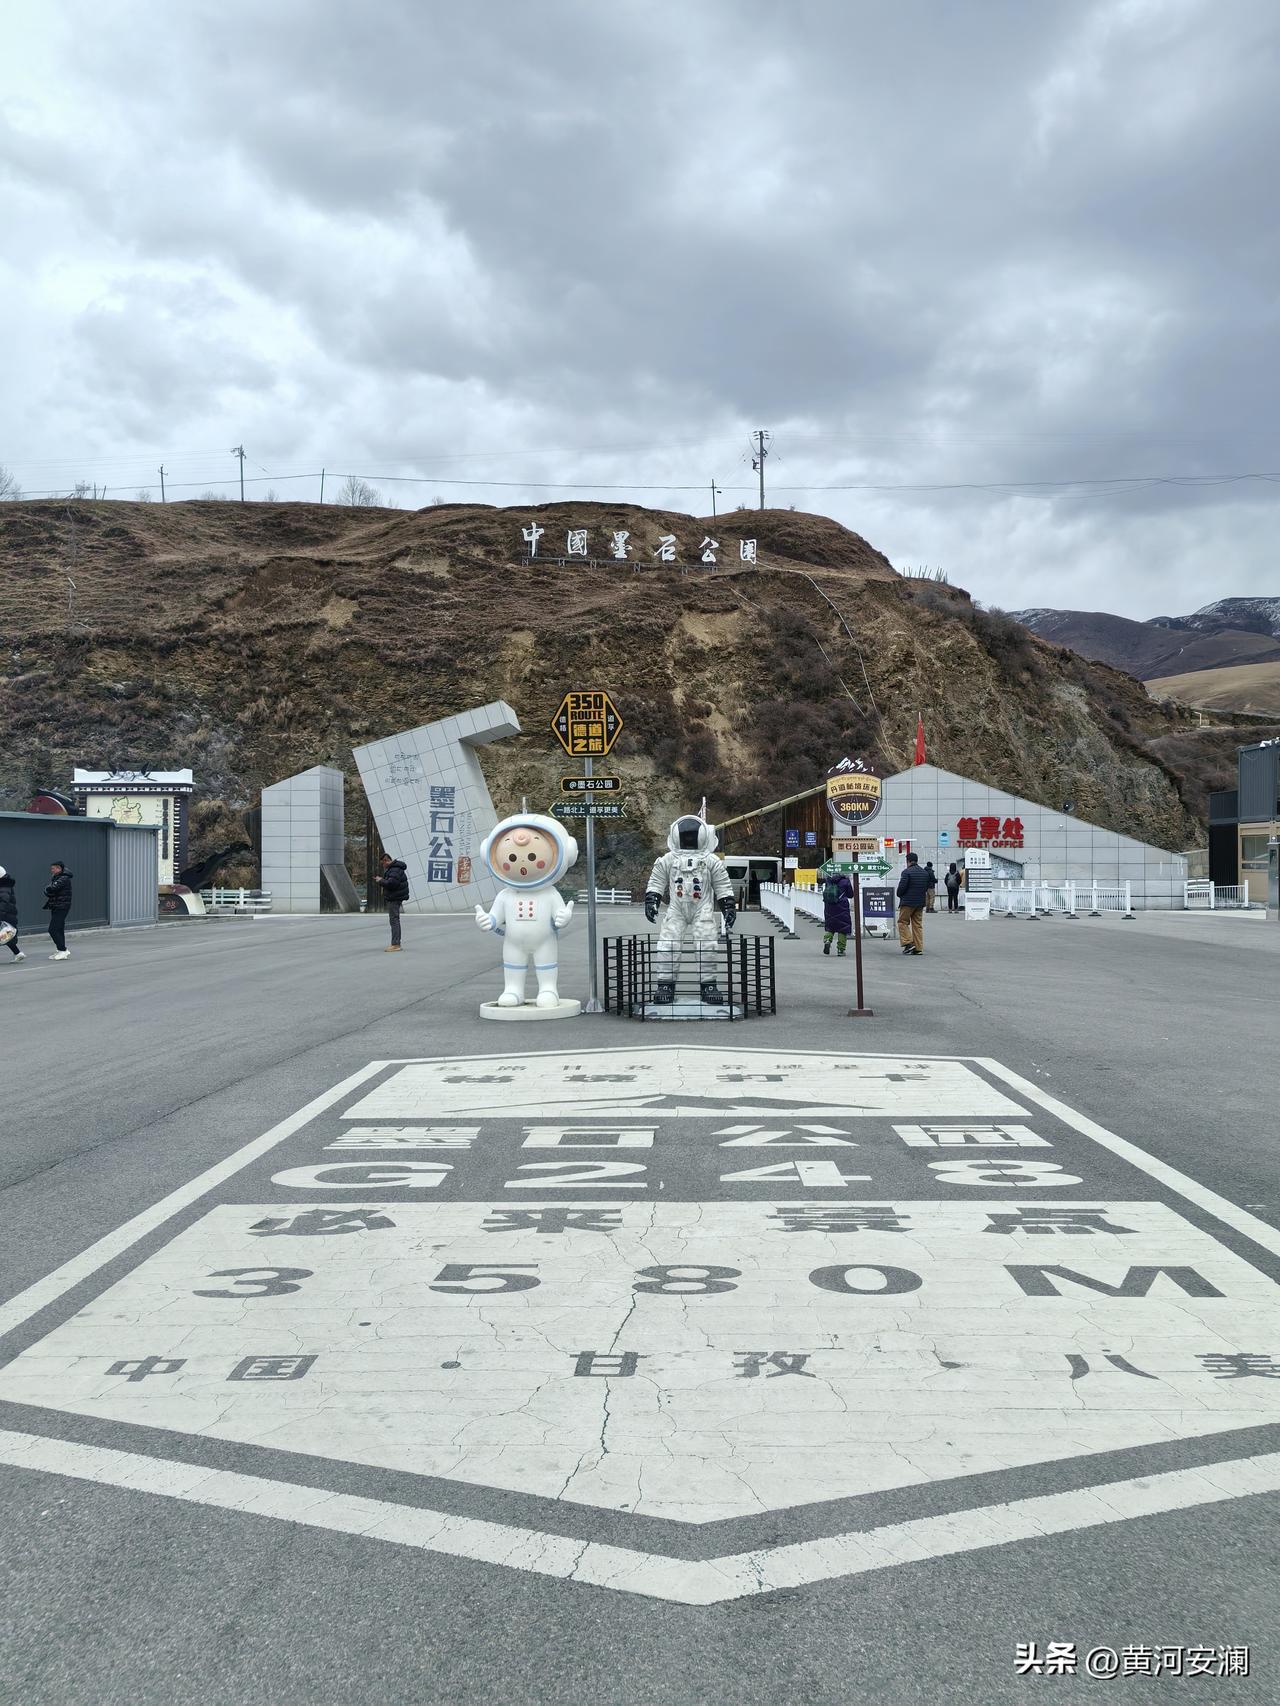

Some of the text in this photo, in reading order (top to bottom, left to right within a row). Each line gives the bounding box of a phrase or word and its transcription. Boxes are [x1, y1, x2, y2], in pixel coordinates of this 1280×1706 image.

[570, 694, 603, 709] 350
[570, 711, 604, 720] ROUTE
[573, 723, 602, 736] 德道
[573, 739, 602, 751] 之旅
[569, 780, 613, 789] @墨石公园
[556, 806, 585, 814] 一路北上
[840, 802, 869, 811] 360KM
[956, 816, 1024, 839] 售票处
[428, 786, 455, 883] 墨石公园
[837, 842, 874, 850] 墨石公园站
[956, 840, 1024, 848] TICKET OFFICE
[323, 1125, 1054, 1149] 墨石公园
[270, 1159, 1084, 1188] G248
[246, 1207, 1141, 1236] 必来景点
[192, 1264, 1227, 1298] 3580M
